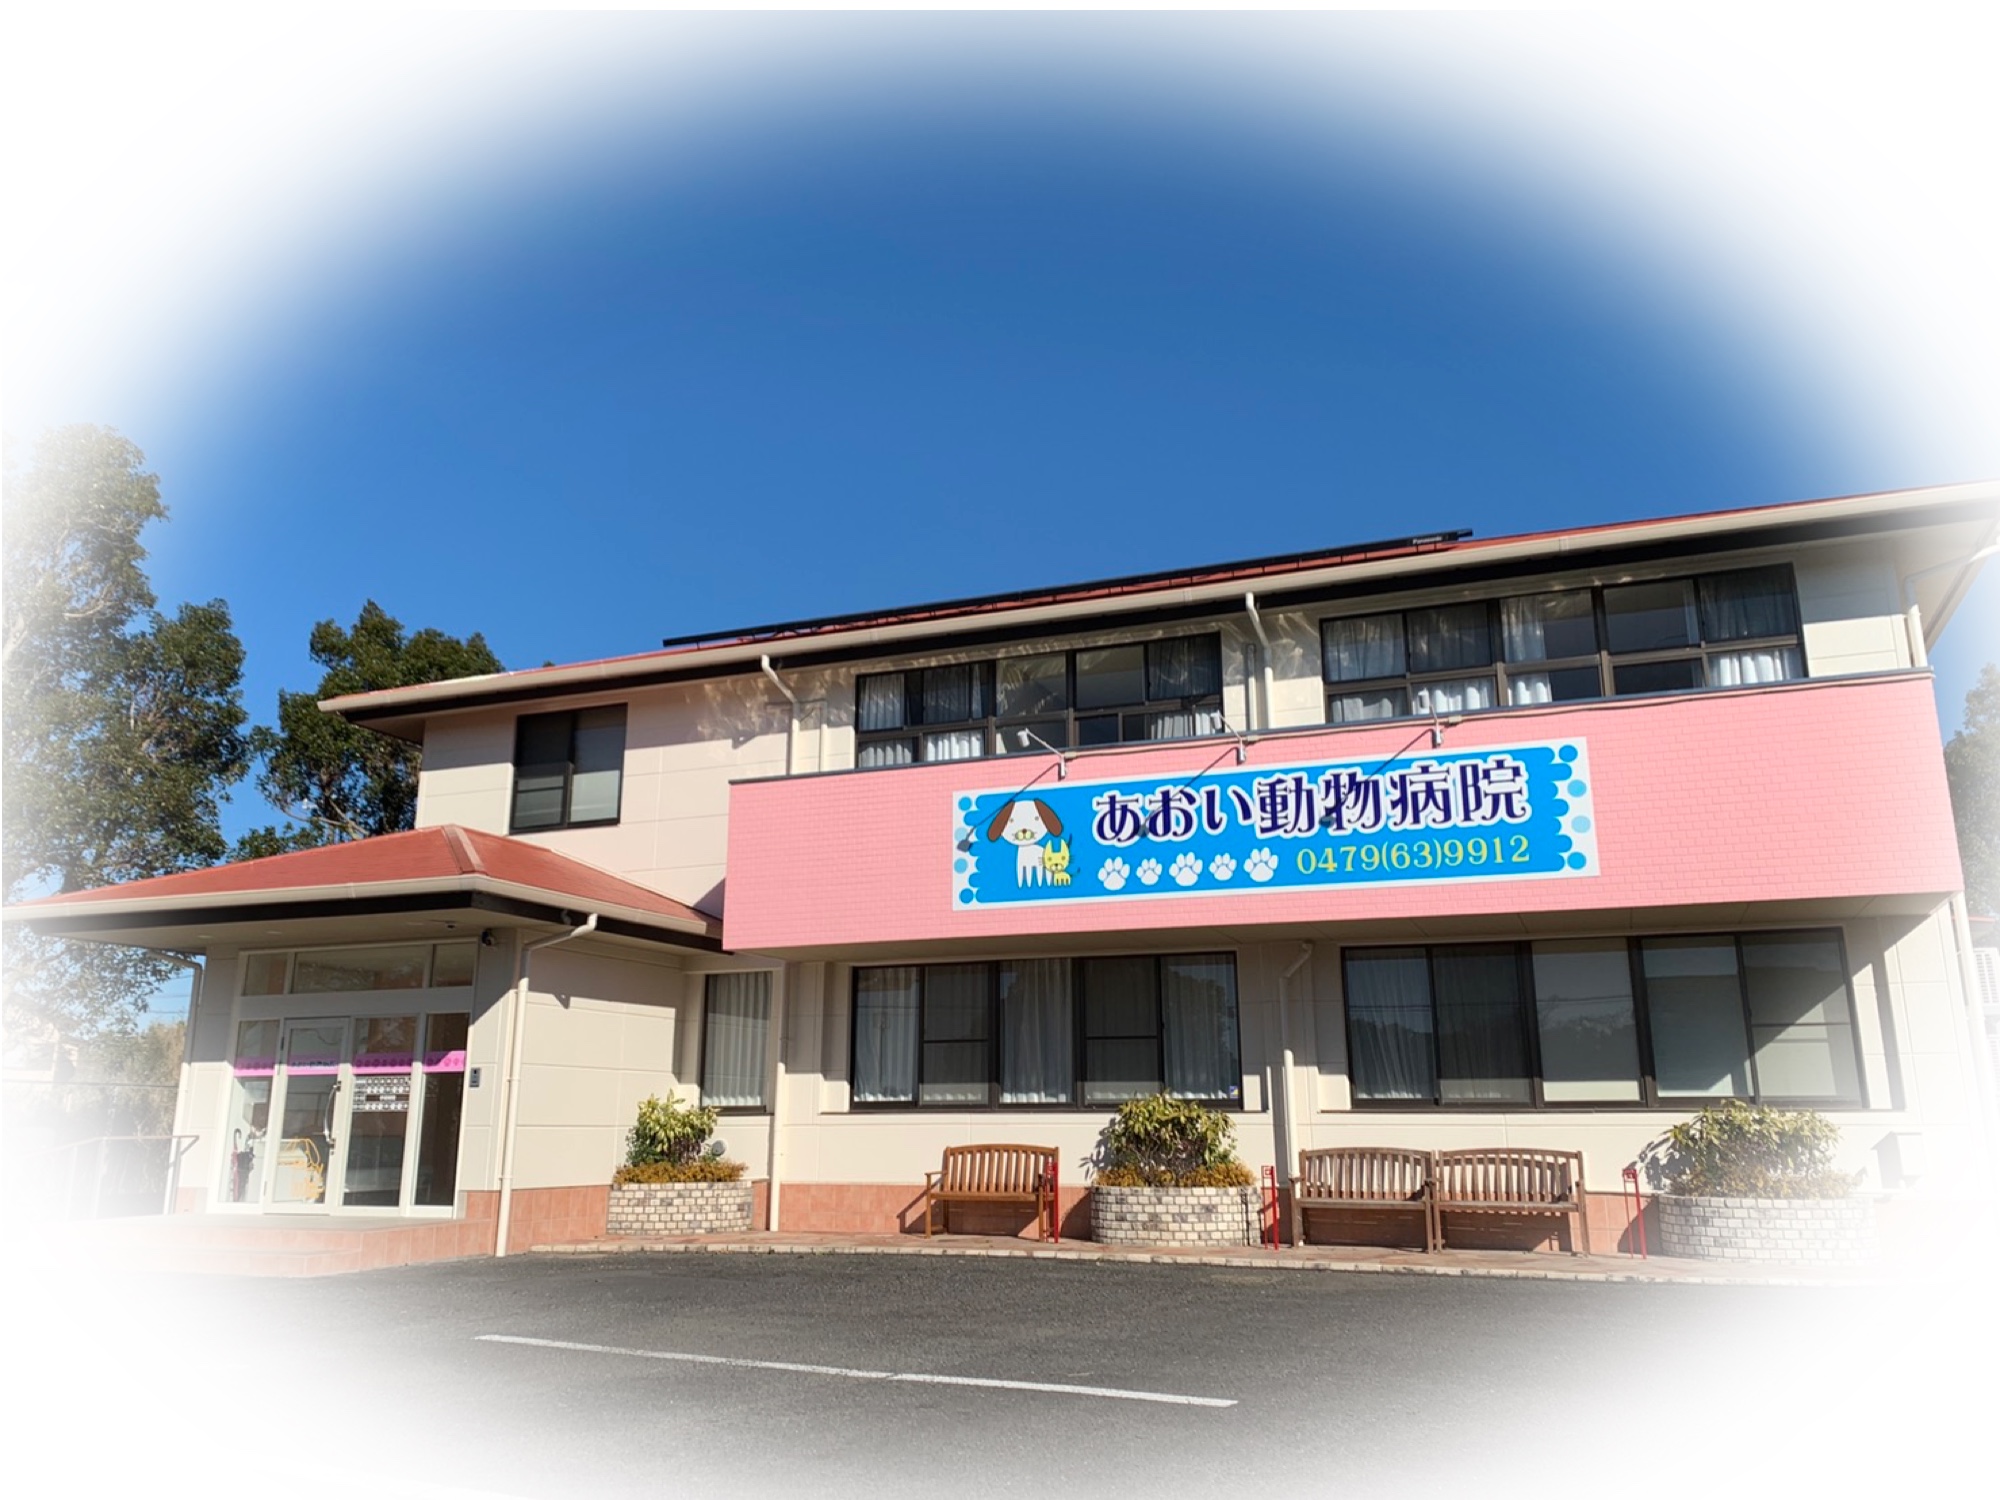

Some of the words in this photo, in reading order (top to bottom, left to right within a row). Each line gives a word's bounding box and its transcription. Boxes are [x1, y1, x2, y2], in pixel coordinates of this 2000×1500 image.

[1096, 759, 1526, 842] あおい動物病院
[1297, 835, 1530, 875] 0479(63)9912
